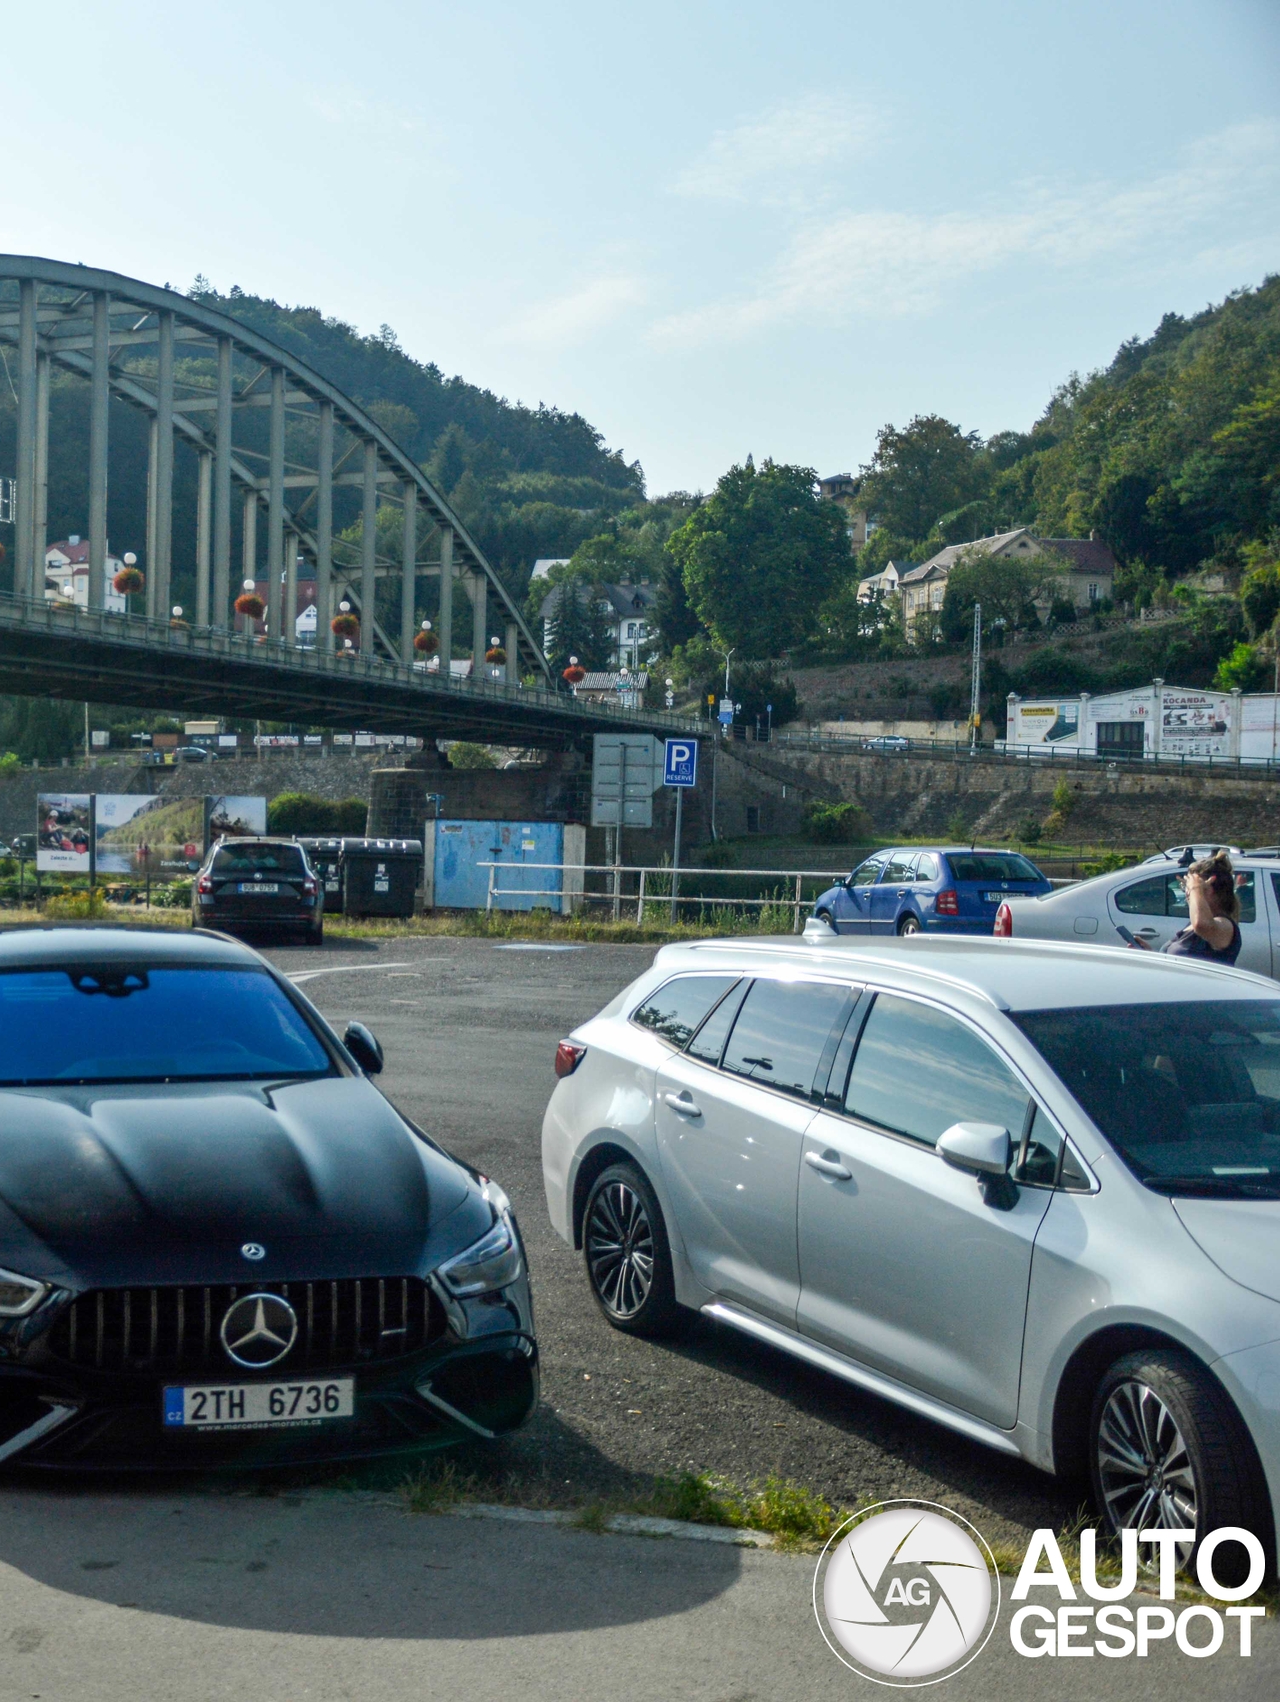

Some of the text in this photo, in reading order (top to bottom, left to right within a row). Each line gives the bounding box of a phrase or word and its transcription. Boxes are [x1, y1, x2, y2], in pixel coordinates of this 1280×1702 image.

[671, 745, 690, 772] P
[666, 773, 693, 781] RÉSERVÉ
[191, 1384, 340, 1421] 2TH 6736
[167, 1411, 182, 1421] CZ
[198, 1418, 323, 1432] www.mercedes-moravia.cz
